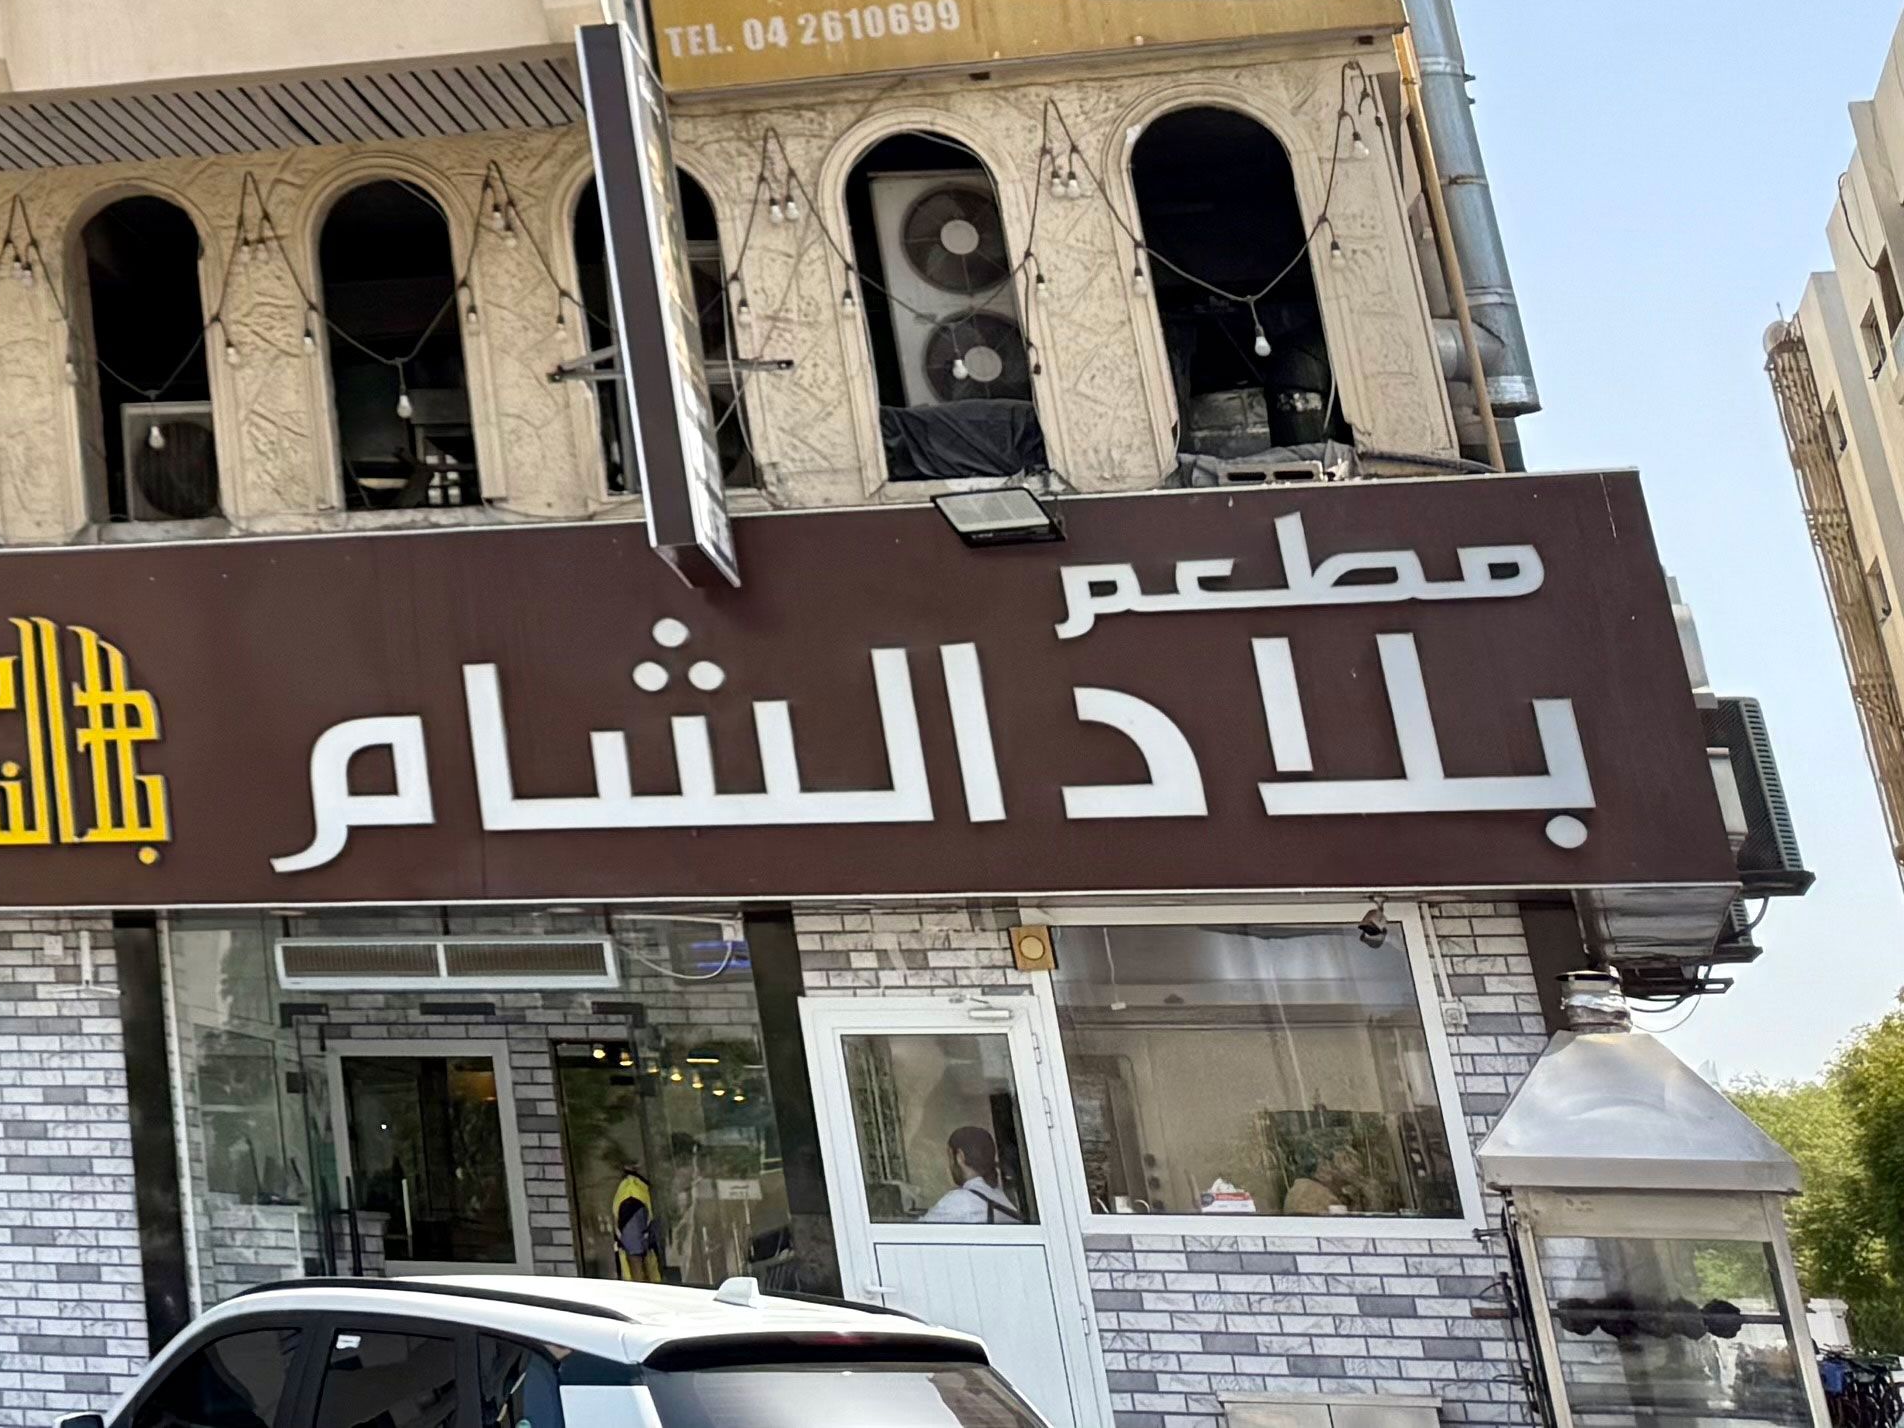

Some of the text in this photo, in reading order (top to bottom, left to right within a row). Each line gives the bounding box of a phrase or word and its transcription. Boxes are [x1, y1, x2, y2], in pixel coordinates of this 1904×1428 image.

[665, 0, 961, 59] TEL. 04 2610699
[1054, 511, 1546, 639] مطعم
[270, 618, 1595, 873] بلاد الشام
